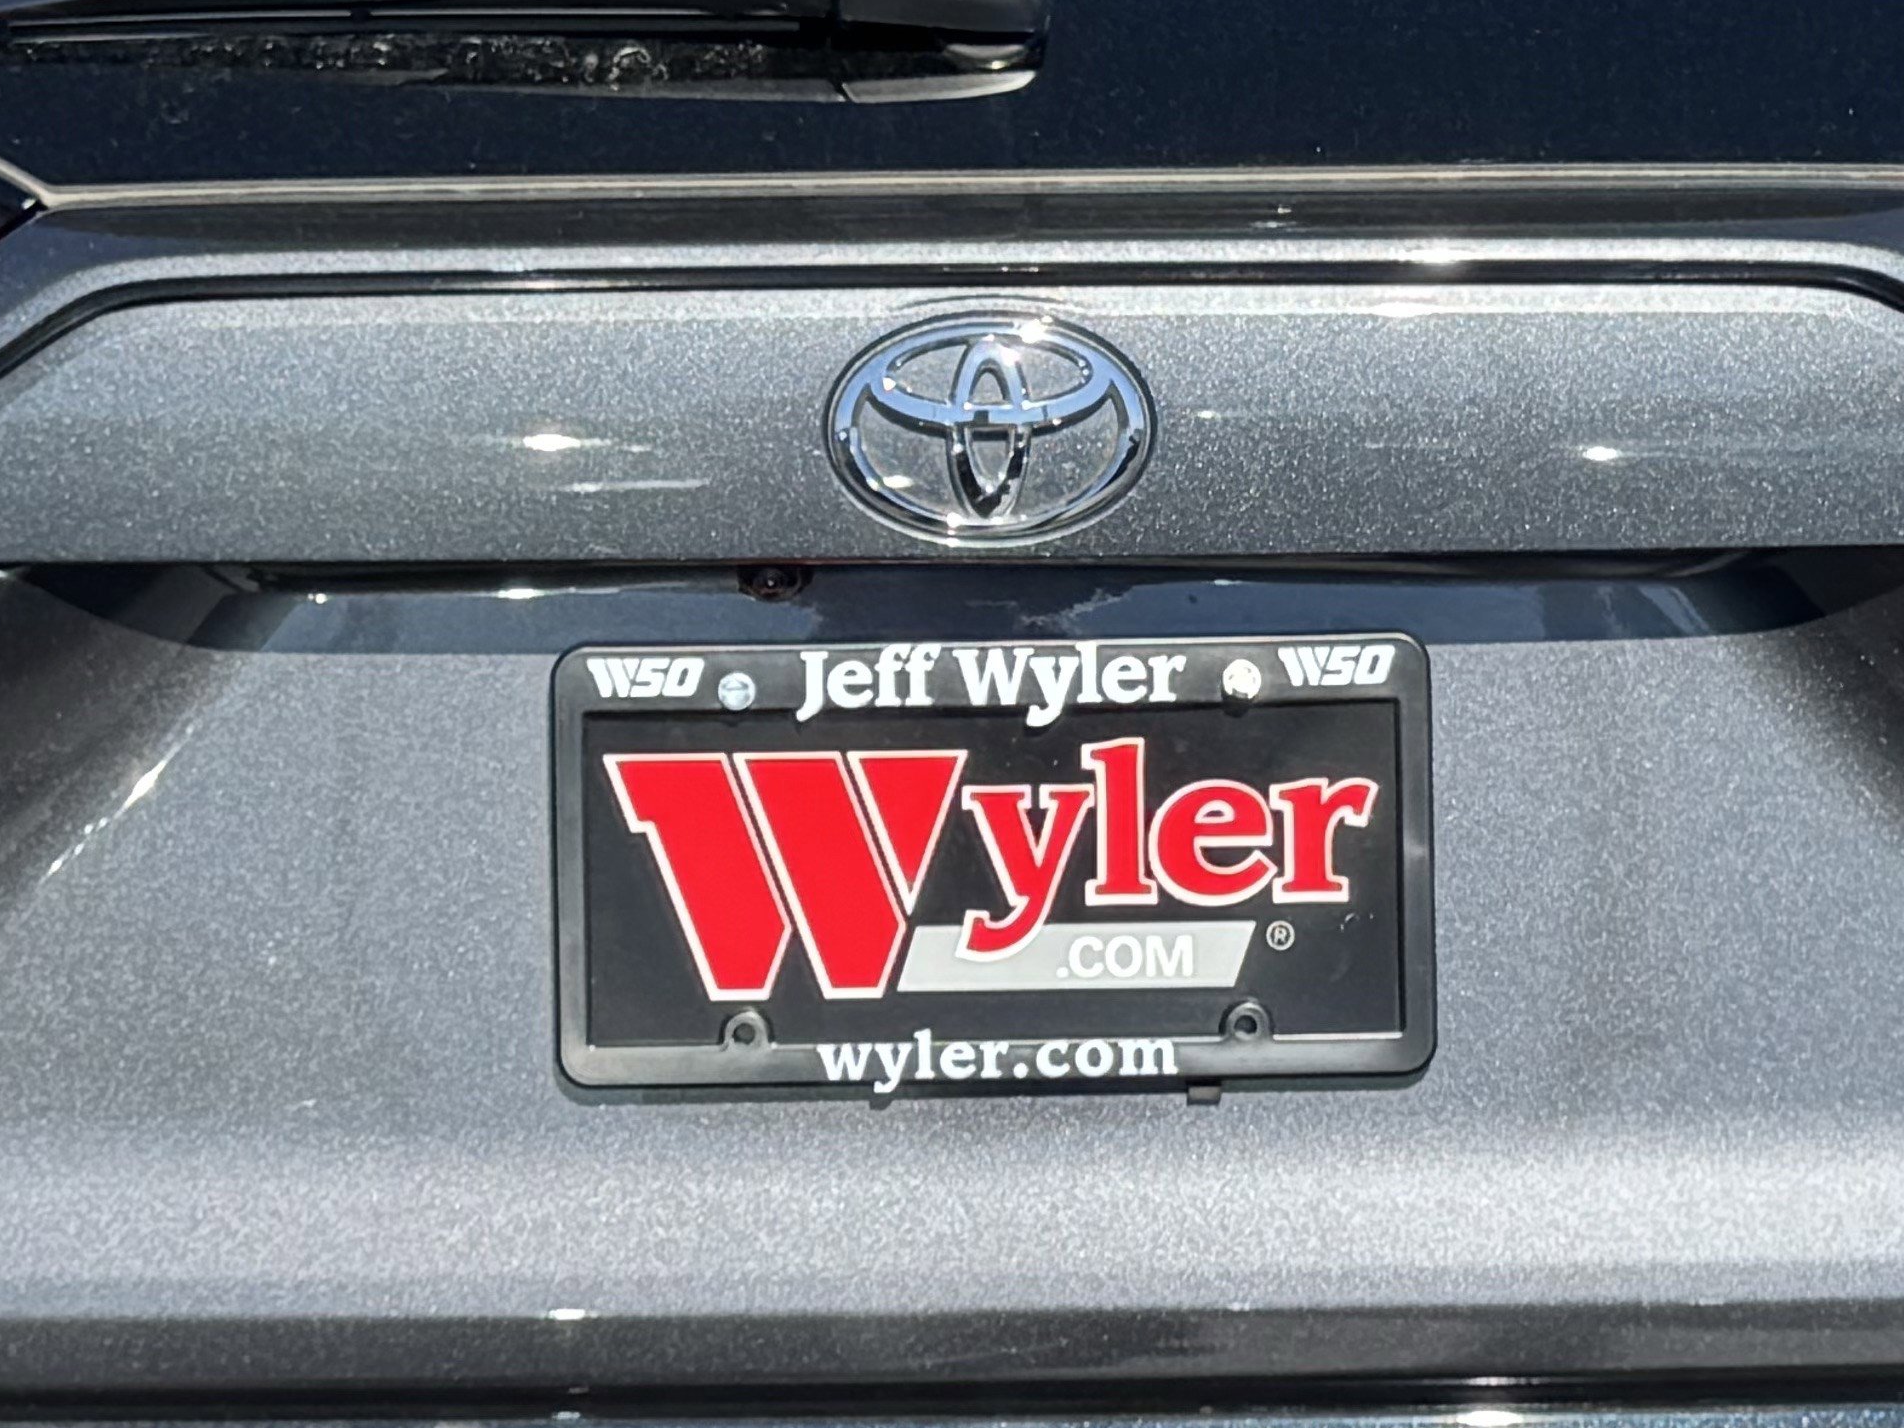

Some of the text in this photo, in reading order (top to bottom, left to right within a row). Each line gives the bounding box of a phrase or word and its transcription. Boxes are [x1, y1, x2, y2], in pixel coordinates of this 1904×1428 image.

[795, 643, 939, 722] Jeff
[951, 638, 1187, 727] Wyler
[602, 736, 1379, 1001] Wyler
[1055, 934, 1195, 979] .COM
[816, 1028, 1179, 1094] wyler.com
